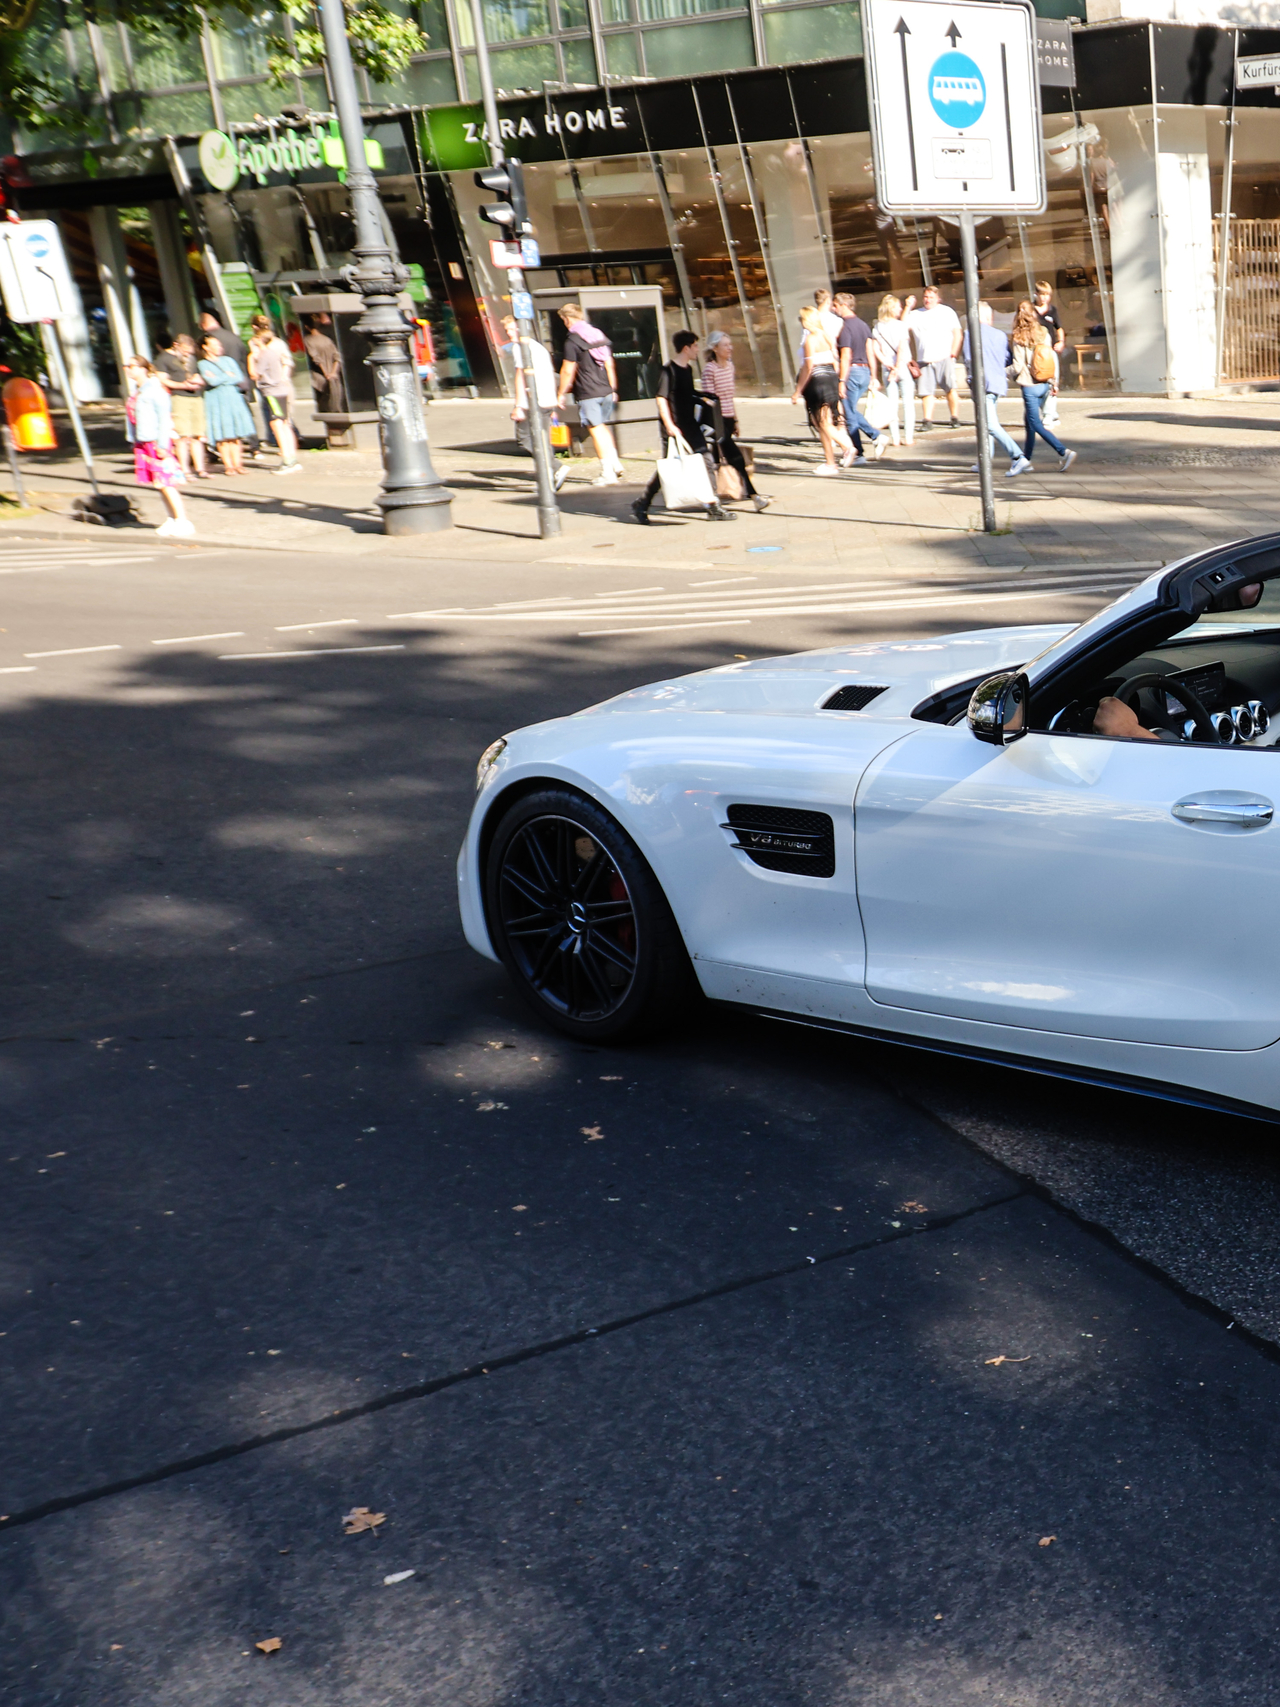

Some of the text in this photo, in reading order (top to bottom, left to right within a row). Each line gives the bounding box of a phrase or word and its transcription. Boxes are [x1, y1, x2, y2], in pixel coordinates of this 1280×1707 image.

[1037, 38, 1068, 51] ZARA
[544, 106, 628, 136] HOME
[238, 124, 325, 186] Apothe
